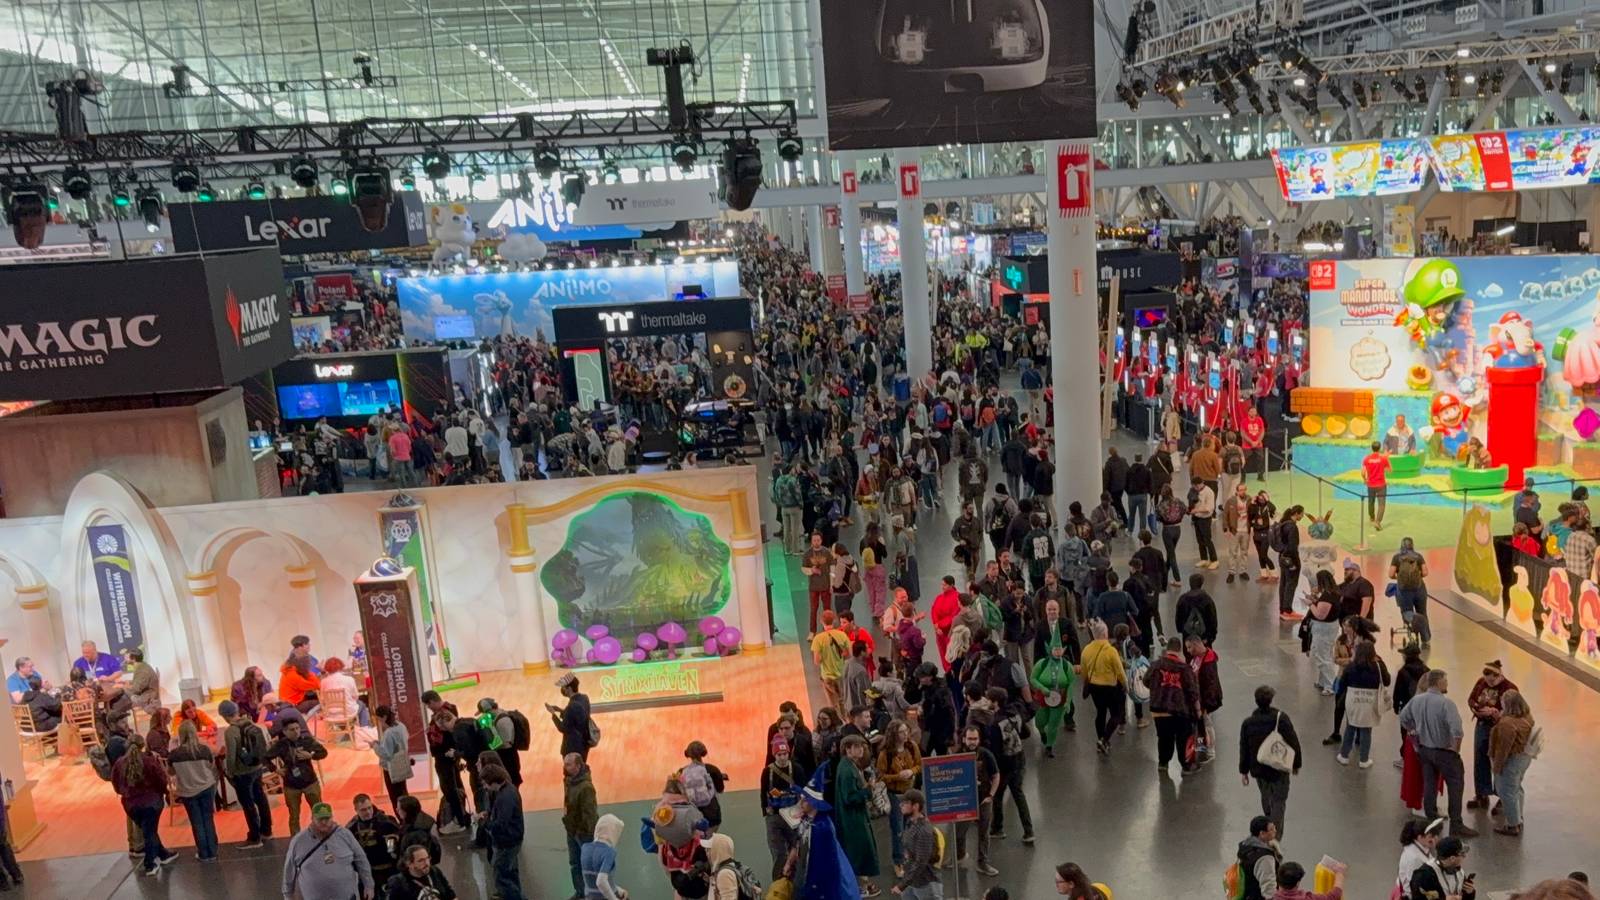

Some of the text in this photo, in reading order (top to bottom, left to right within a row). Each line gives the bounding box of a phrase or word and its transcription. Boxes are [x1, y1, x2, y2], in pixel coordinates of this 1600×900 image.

[244, 215, 331, 242] Lexar
[318, 284, 345, 296] Poland
[1354, 279, 1385, 289] SUPER
[1341, 289, 1370, 303] MARIO
[239, 294, 280, 333] MAGIC
[1347, 304, 1394, 317] WONDER
[640, 312, 706, 328] thermaltake
[0, 315, 162, 358] MAGIC
[20, 354, 104, 370] GATHERING
[112, 571, 132, 639] WITHERBLOOM
[381, 632, 391, 659] COLLEGE
[385, 660, 392, 668] OF
[391, 646, 408, 703] LOREHOLD
